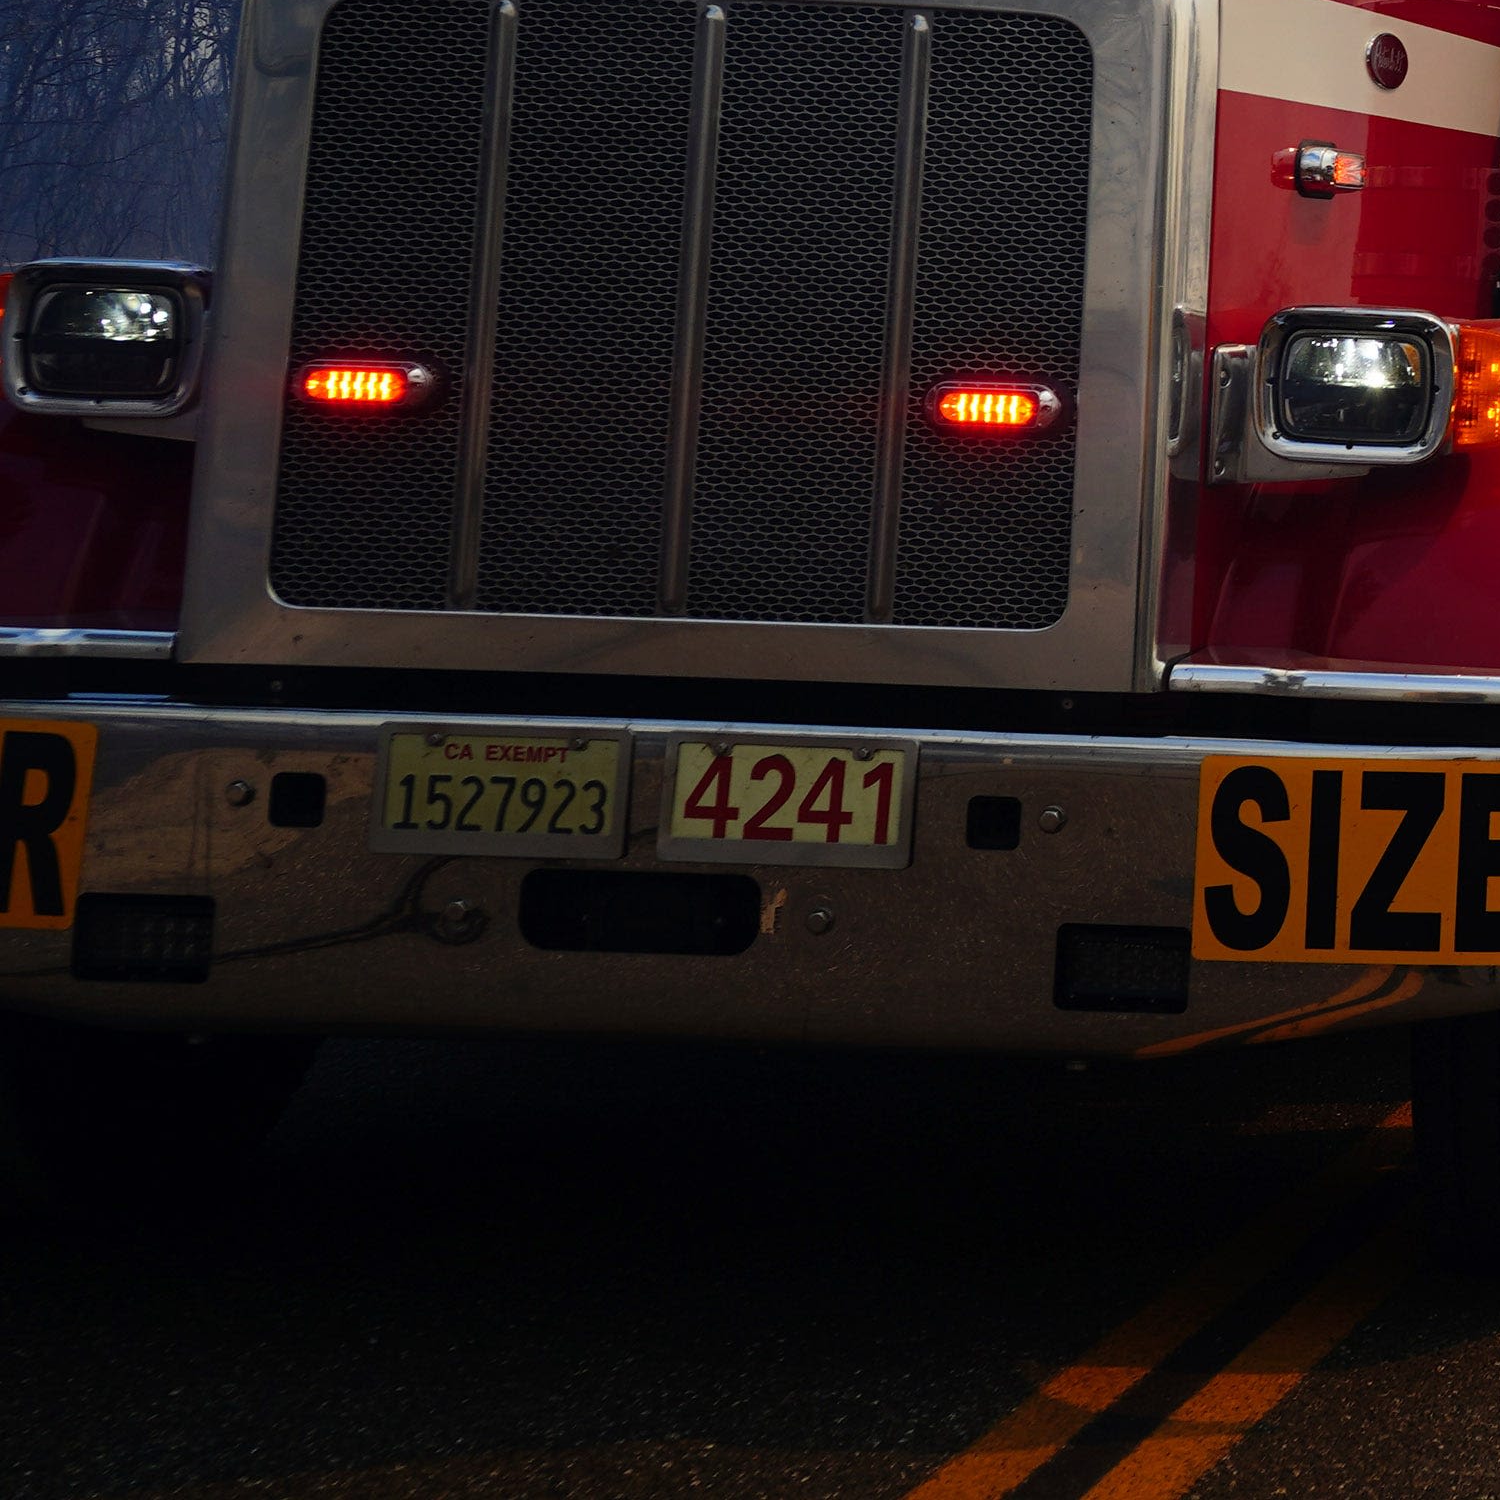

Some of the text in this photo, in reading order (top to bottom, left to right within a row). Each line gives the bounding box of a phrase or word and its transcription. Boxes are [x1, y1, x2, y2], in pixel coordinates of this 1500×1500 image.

[445, 743, 570, 763] CA EXEMPT
[0, 730, 76, 916] R
[392, 773, 608, 835] 1527923
[683, 753, 895, 845] 4241
